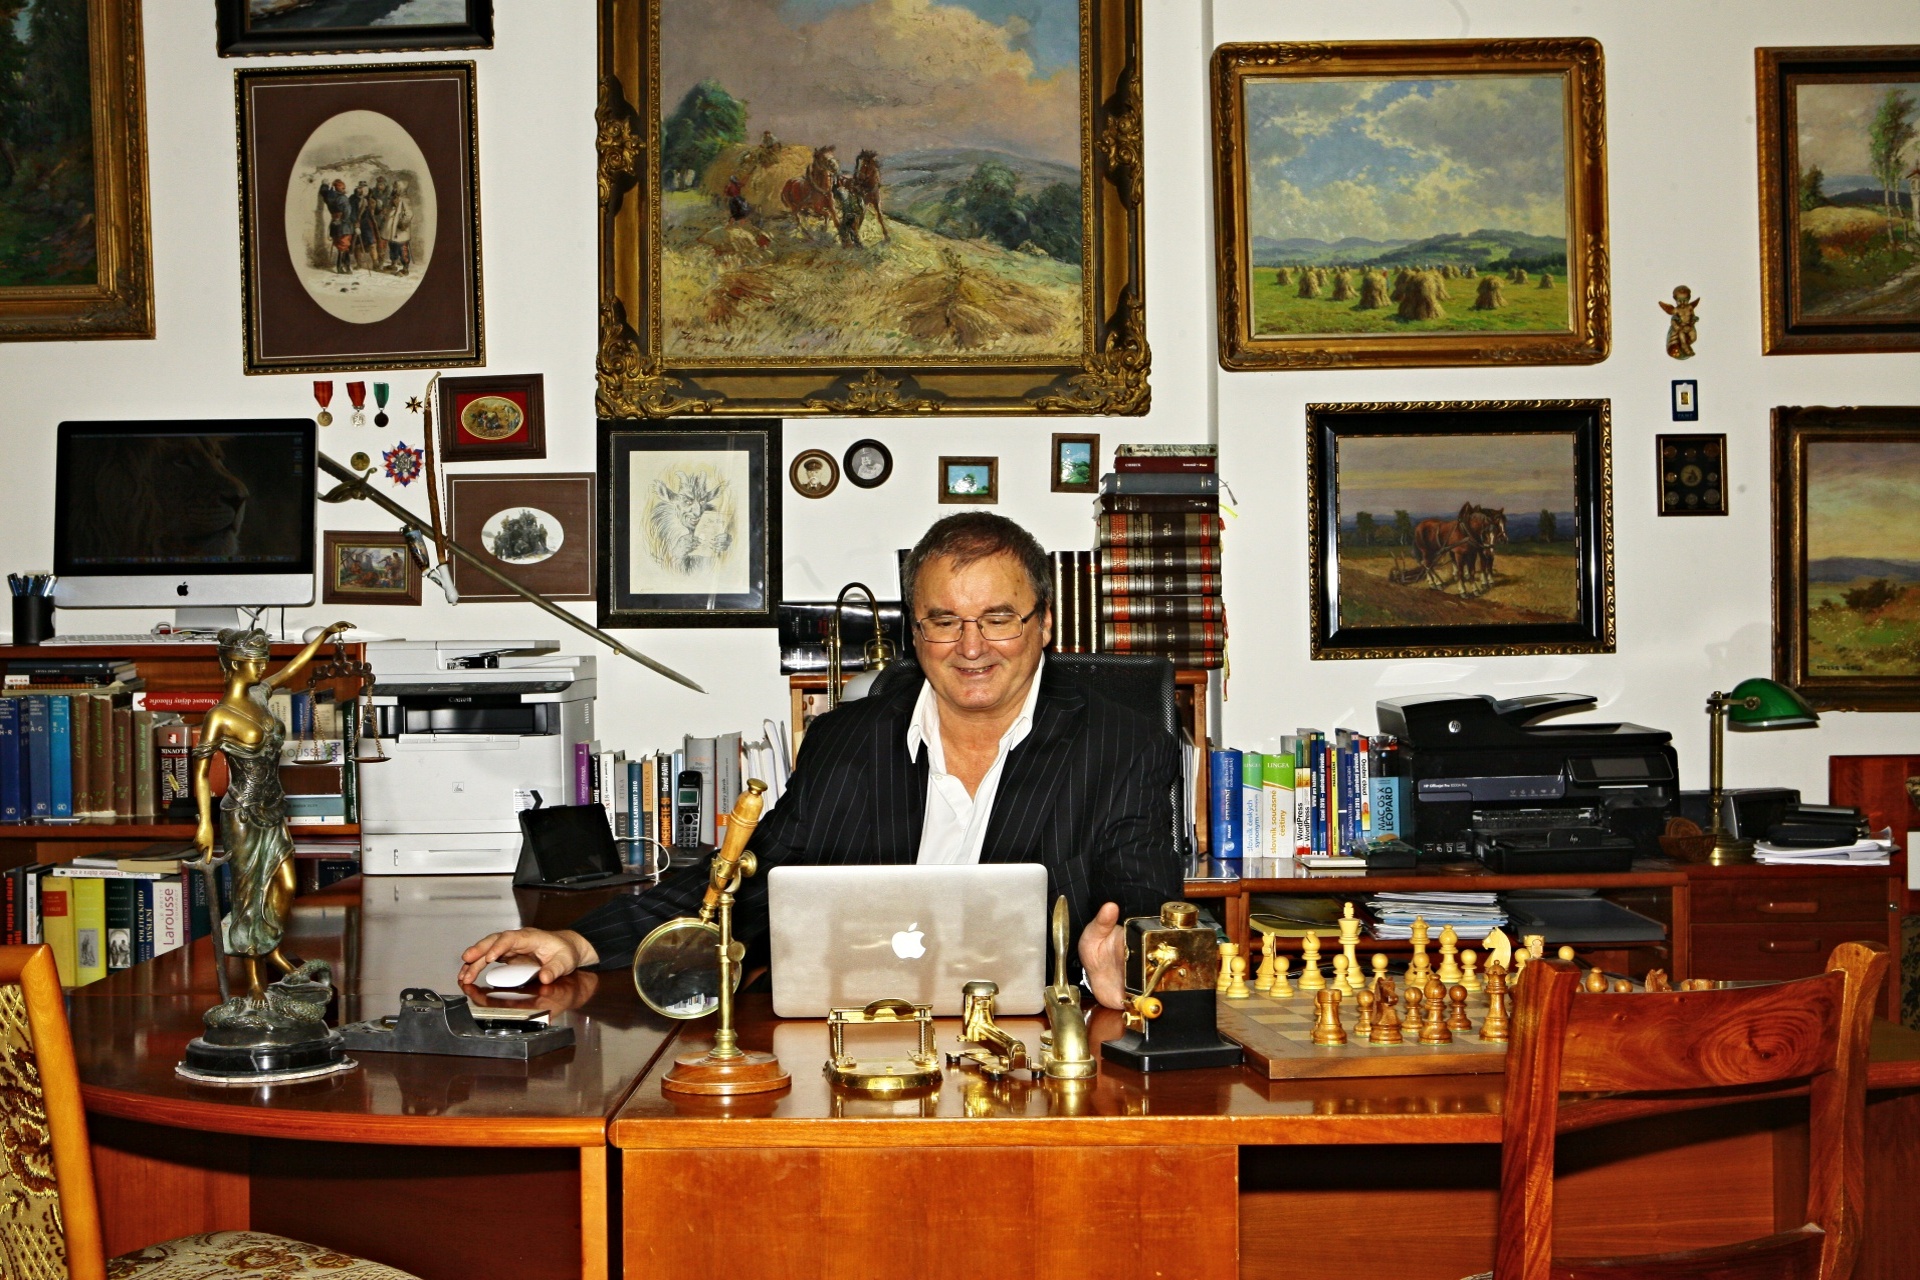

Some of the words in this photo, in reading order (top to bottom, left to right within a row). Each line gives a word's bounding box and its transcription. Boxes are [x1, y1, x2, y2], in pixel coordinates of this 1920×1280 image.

[149, 698, 173, 706] filozofie
[174, 697, 191, 706] dějiny
[192, 698, 219, 706] Obrazové
[661, 762, 669, 776] RATH
[661, 777, 669, 792] David
[660, 797, 671, 805] SI
[1246, 799, 1255, 827] českých
[1269, 790, 1277, 826] současné
[1377, 794, 1385, 808] OS
[1385, 786, 1394, 831] LEOPARD
[1278, 810, 1287, 836] češtiny
[1296, 802, 1304, 841] WordPress
[1569, 834, 1578, 844] hp
[198, 874, 206, 907] CONCISE
[137, 890, 145, 943] POLITICKÉHO
[144, 908, 153, 943] MYŠLENÍ
[163, 888, 174, 945] Larousse
